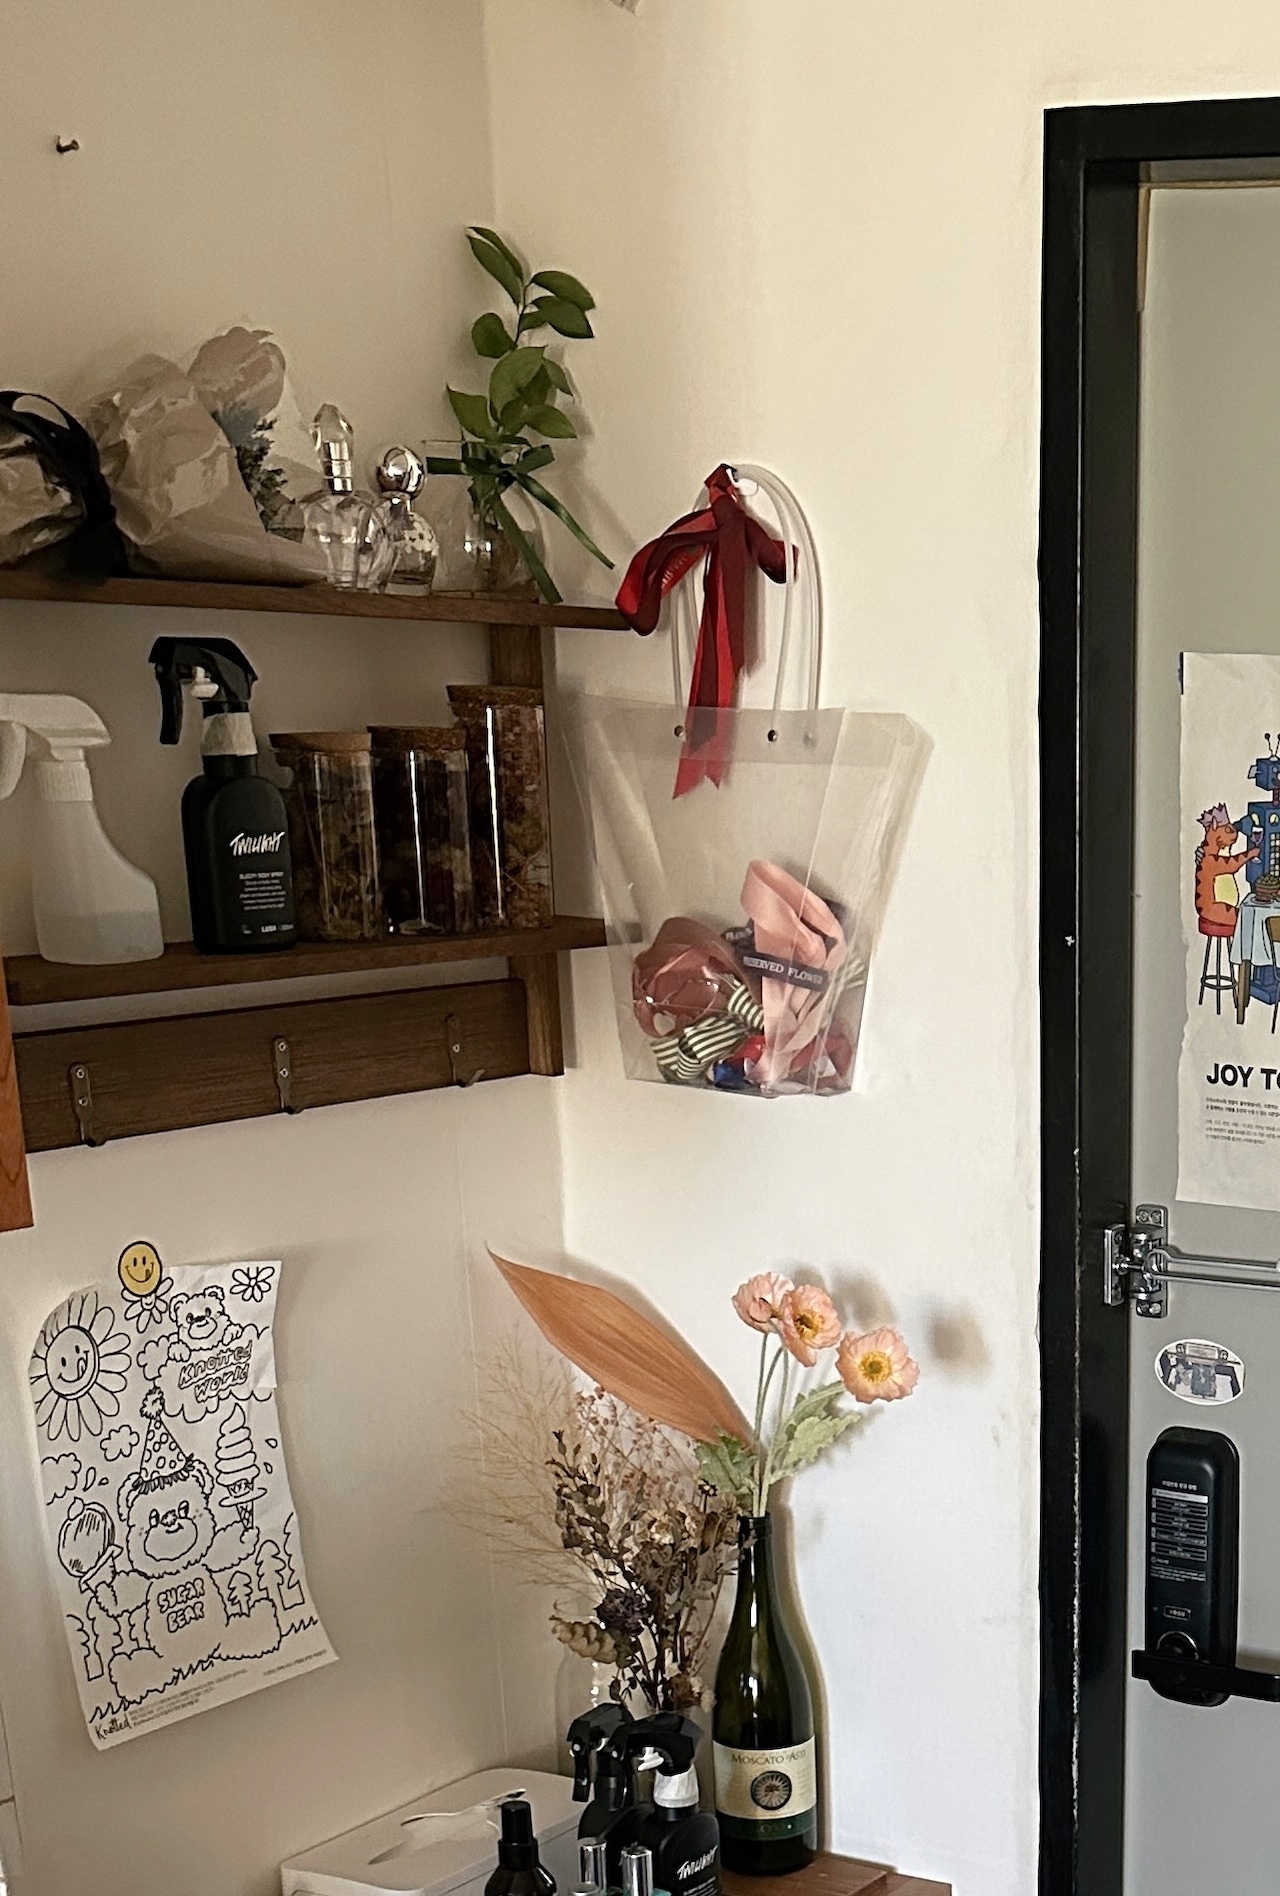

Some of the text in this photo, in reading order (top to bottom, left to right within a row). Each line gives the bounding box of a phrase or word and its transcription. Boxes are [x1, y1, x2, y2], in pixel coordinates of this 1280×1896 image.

[229, 831, 286, 857] TWILIGHT
[1206, 1062, 1254, 1088] JOY
[157, 1577, 206, 1614] SUGAR
[167, 1601, 206, 1634] BEAR
[94, 1712, 132, 1740] Knotted
[731, 1753, 785, 1766] MOSCATO
